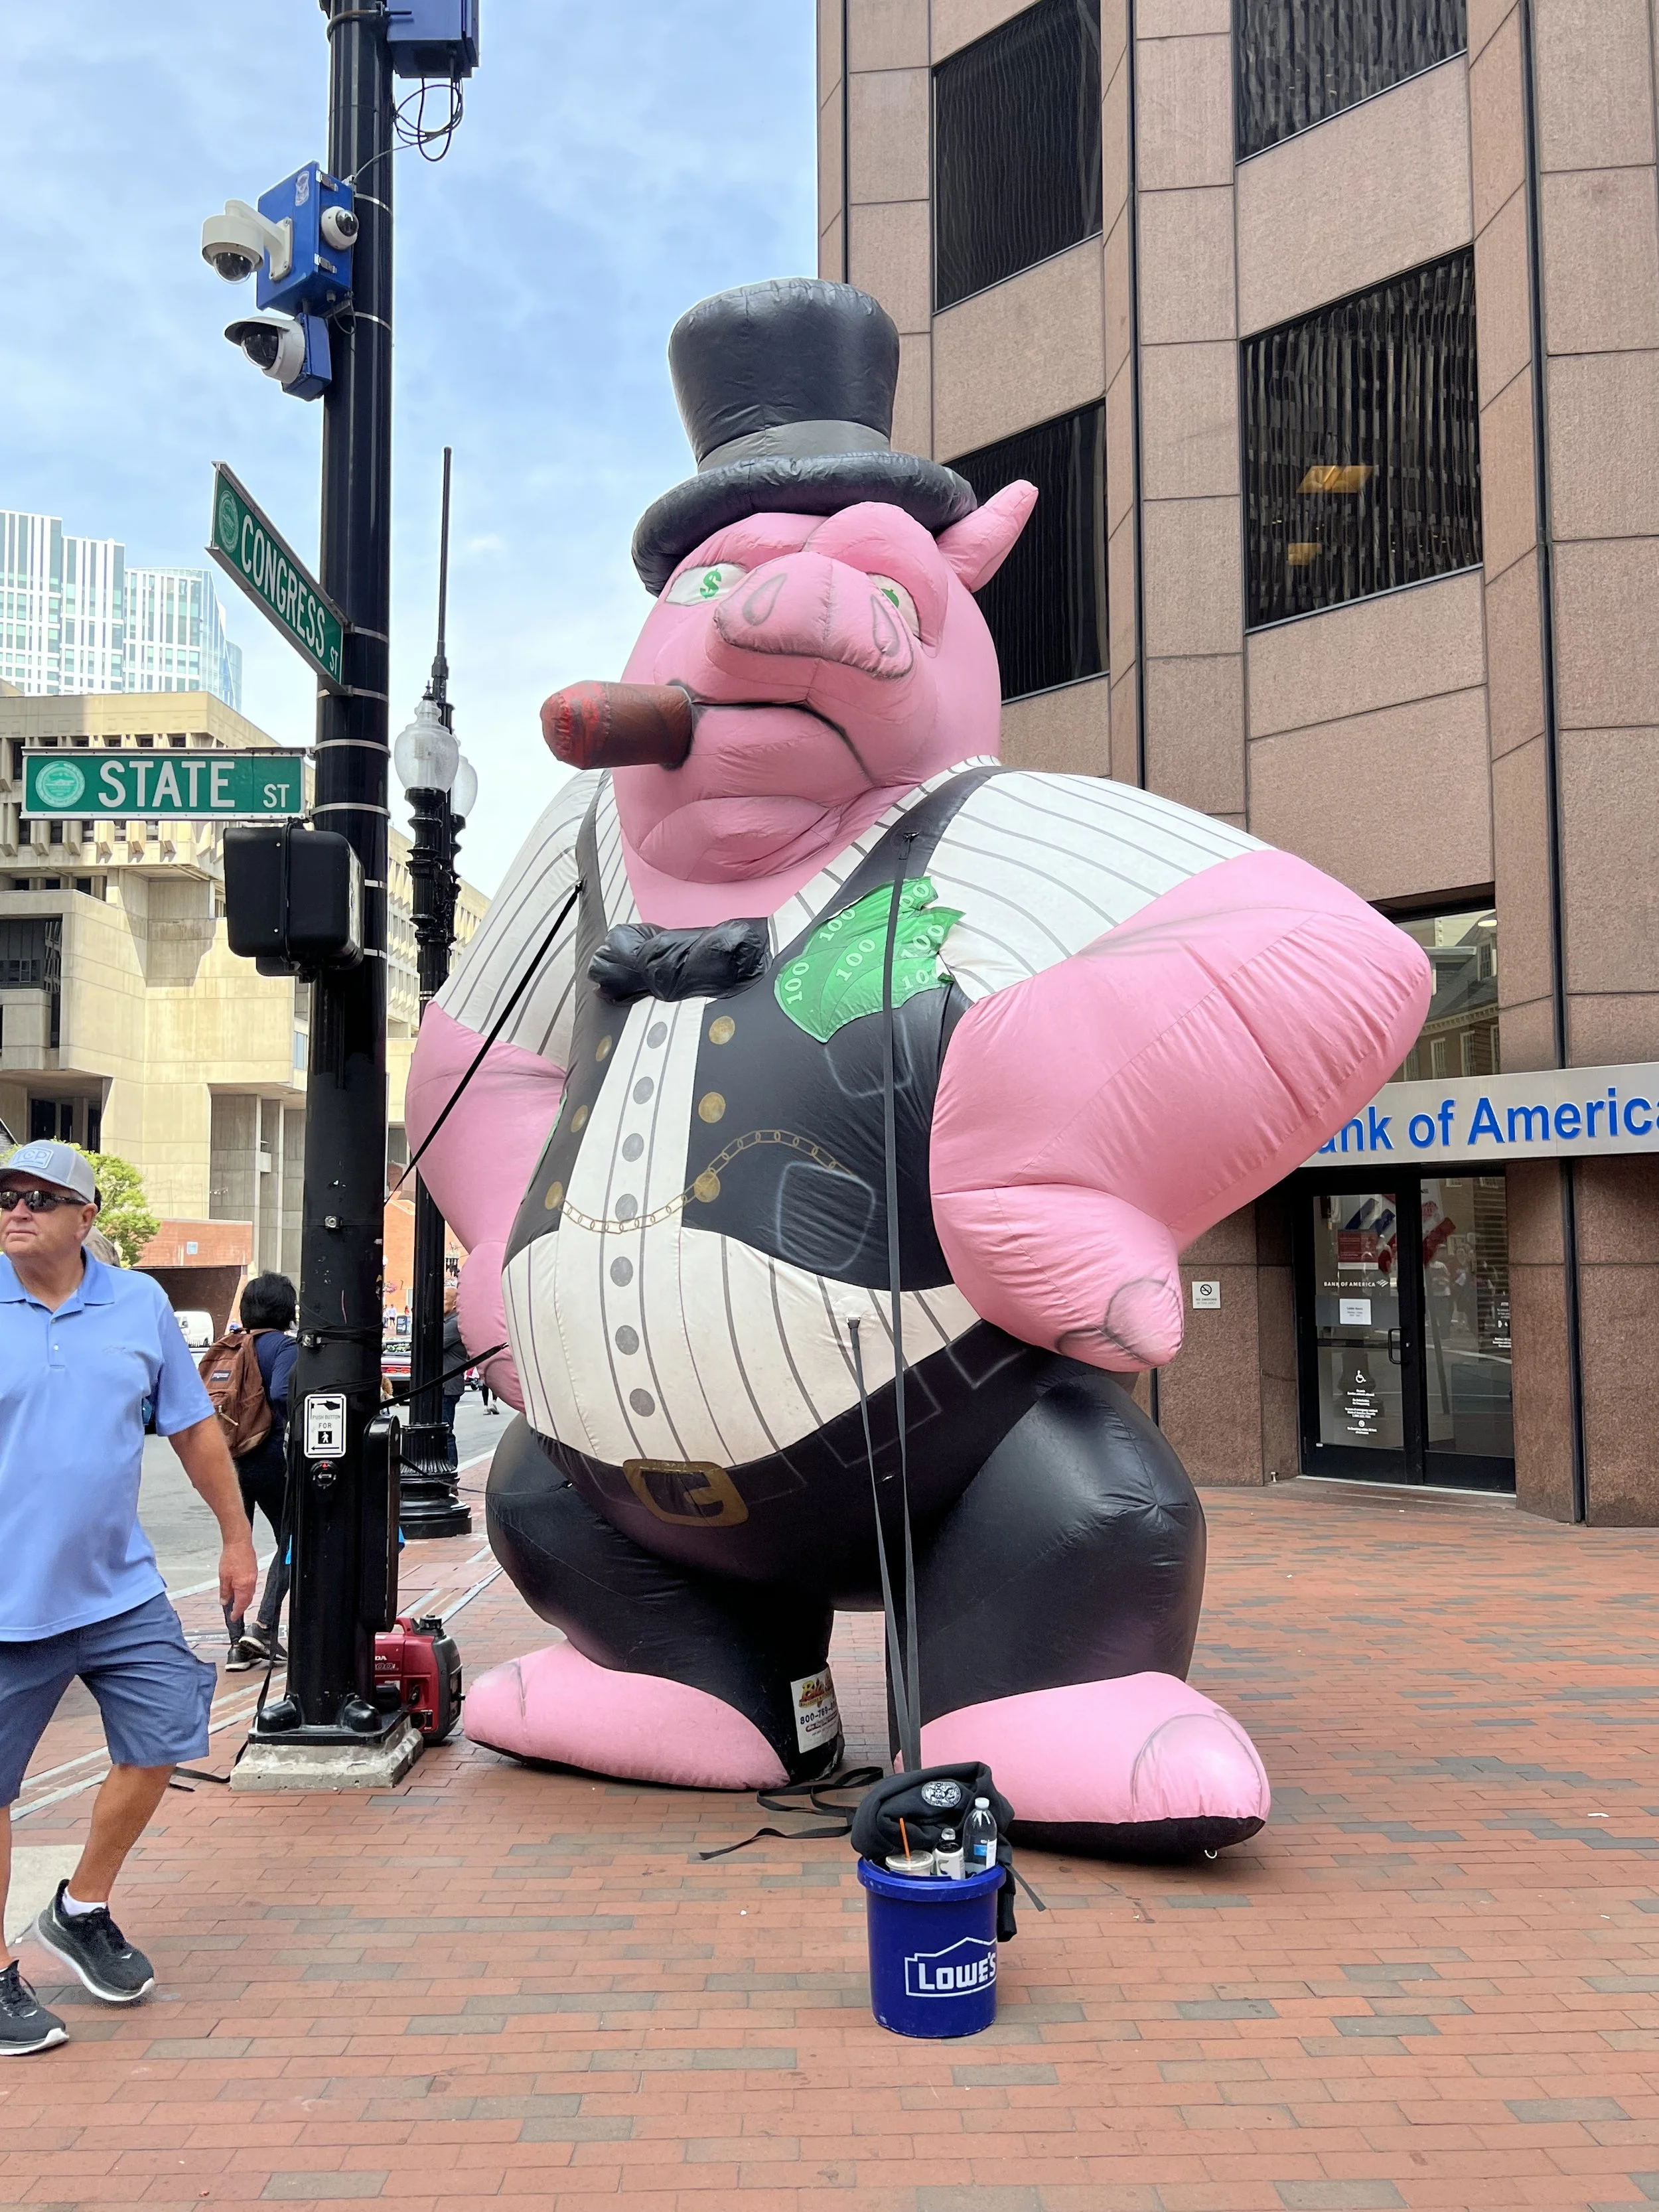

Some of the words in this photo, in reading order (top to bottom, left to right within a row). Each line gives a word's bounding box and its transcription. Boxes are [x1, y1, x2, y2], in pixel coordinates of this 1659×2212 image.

[241, 514, 325, 658] CONGRESS
[330, 646, 339, 676] ST
[98, 760, 236, 808] STATE
[263, 783, 290, 808] ST
[818, 908, 856, 941] 100
[901, 924, 944, 959] 100
[835, 938, 876, 982] 100
[901, 969, 938, 991] 10
[784, 962, 810, 1005] 100
[1408, 1099, 1457, 1149] of
[1467, 1086, 1659, 1145] Americ
